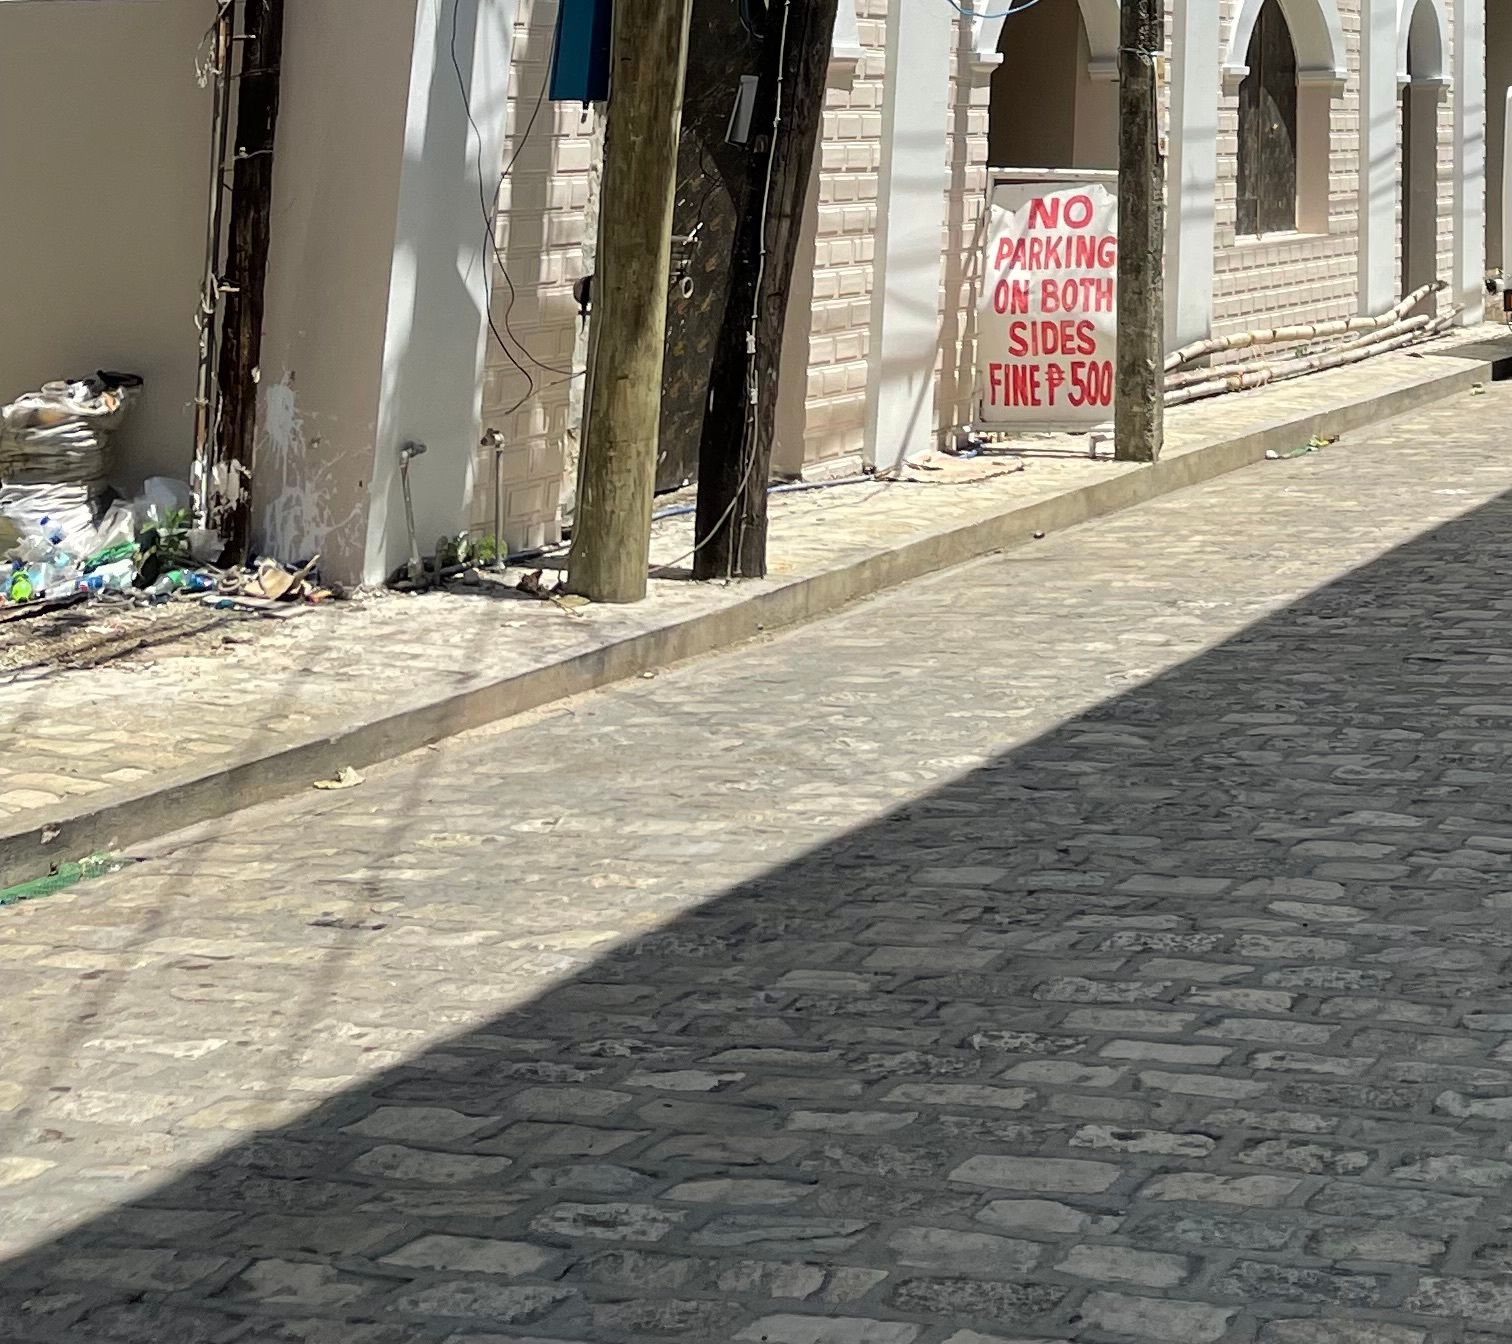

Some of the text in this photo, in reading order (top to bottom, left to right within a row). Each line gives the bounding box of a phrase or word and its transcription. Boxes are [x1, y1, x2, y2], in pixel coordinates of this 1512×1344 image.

[1028, 194, 1093, 230] NO
[994, 235, 1118, 271] PARKING
[993, 277, 1113, 315] ON BOTH
[1008, 319, 1096, 357] SIDES
[988, 363, 1042, 407] FINE
